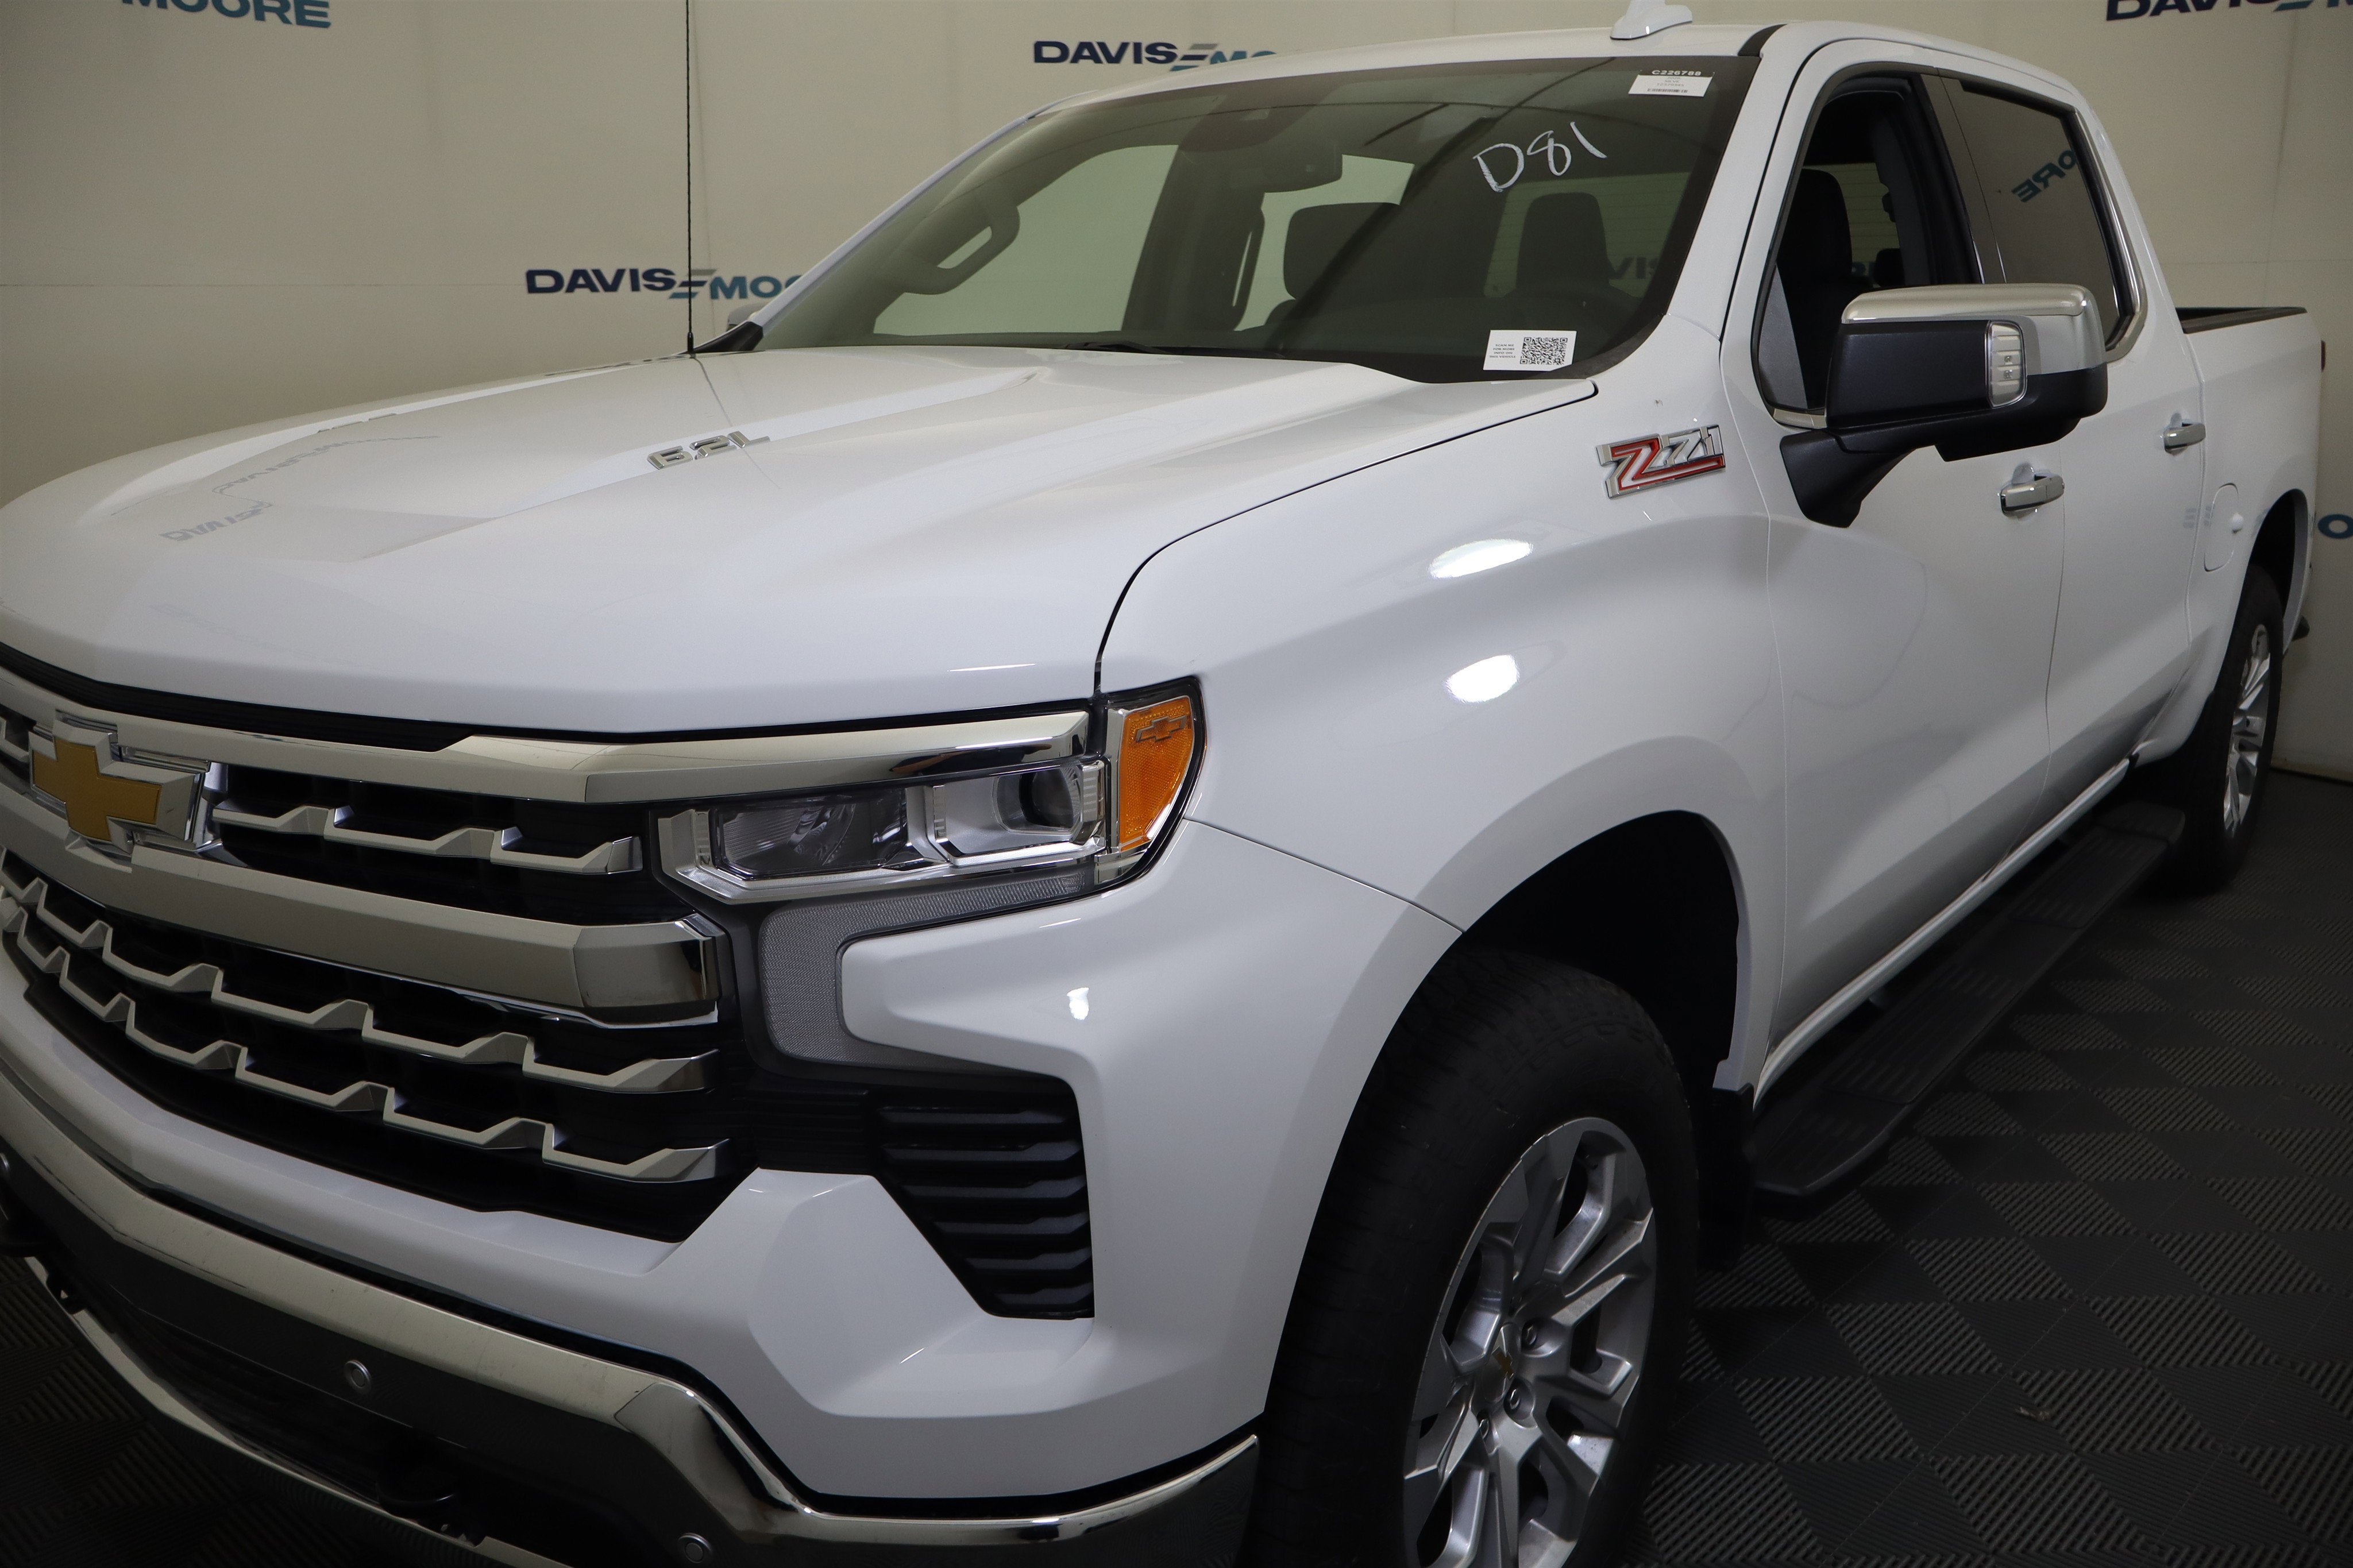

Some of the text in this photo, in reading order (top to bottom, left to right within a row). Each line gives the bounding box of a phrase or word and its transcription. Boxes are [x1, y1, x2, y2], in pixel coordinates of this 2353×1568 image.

[1033, 40, 1178, 64] DAVIS
[1472, 122, 1607, 192] D81
[525, 268, 677, 294] DAVIS
[1596, 424, 1726, 499] Z71
